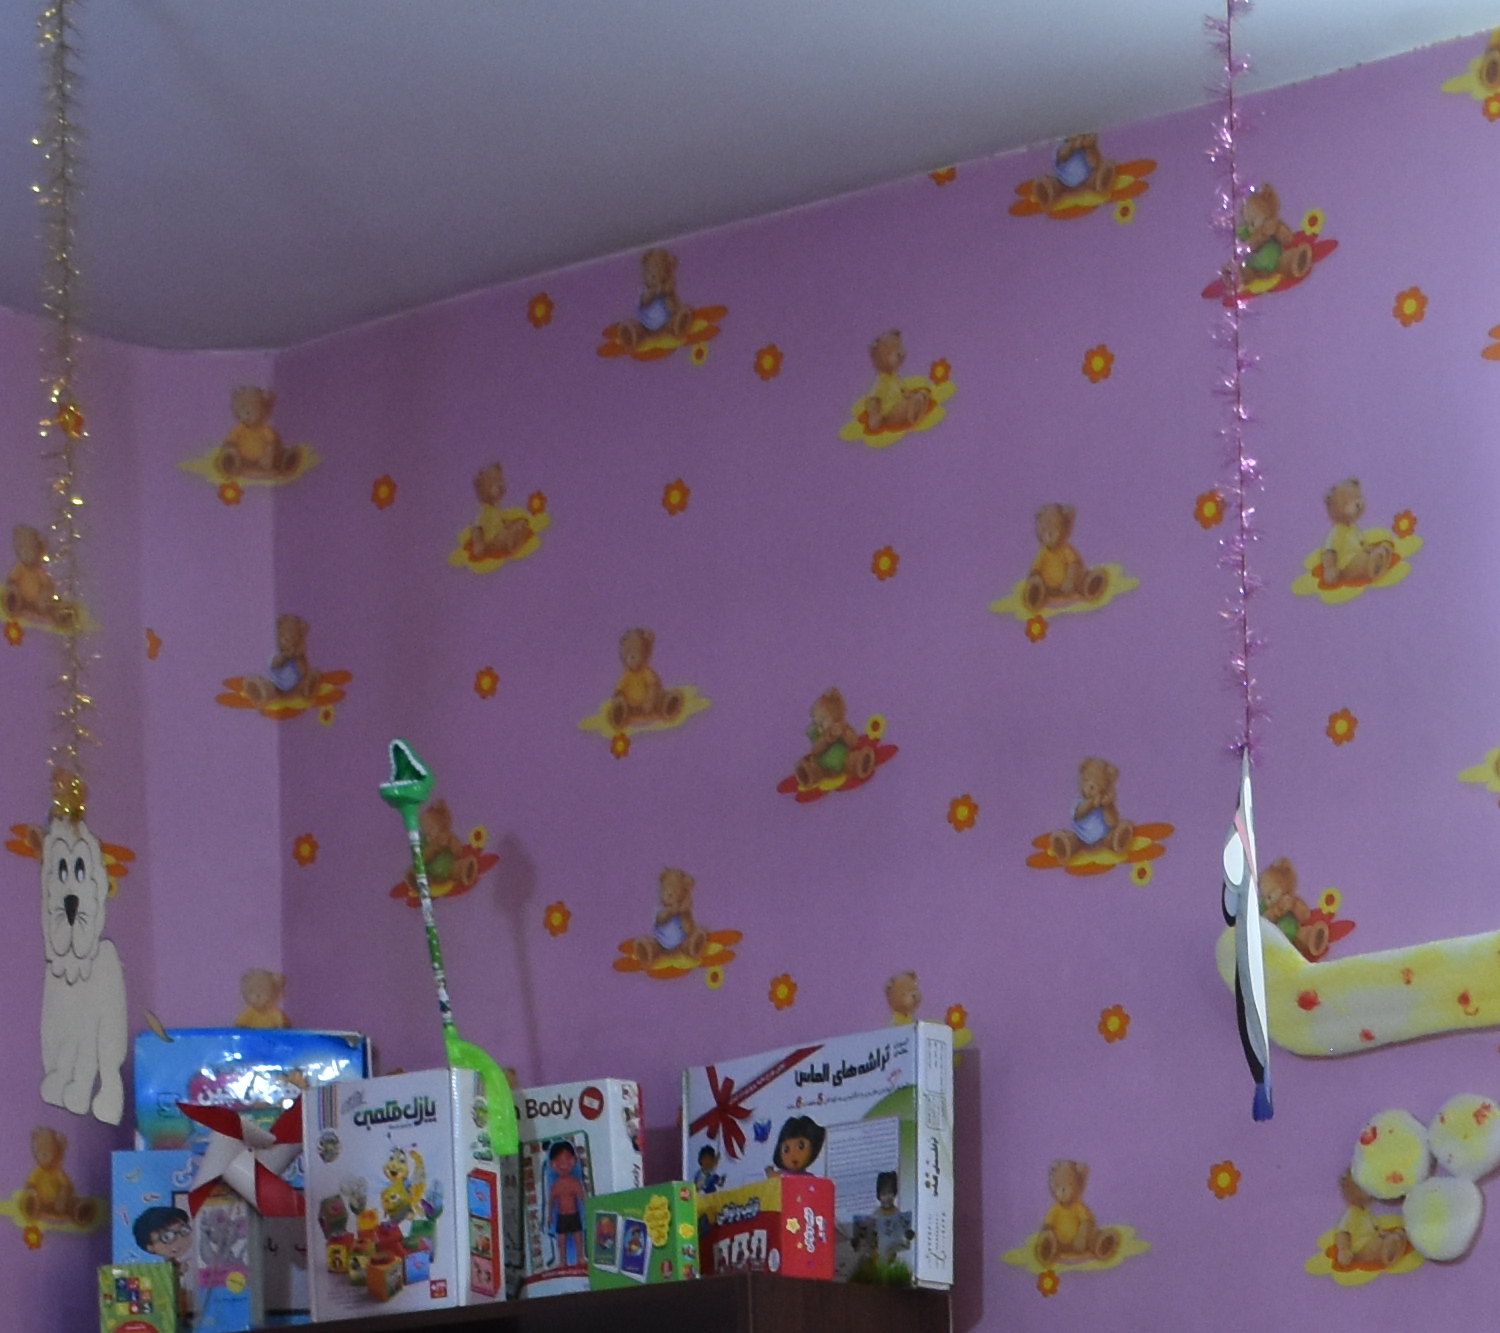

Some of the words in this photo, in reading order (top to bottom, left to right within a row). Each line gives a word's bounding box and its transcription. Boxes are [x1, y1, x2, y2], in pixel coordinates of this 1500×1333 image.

[795, 1063, 830, 1088] الماس
[403, 1096, 437, 1126] پازل
[525, 1094, 574, 1120] Body
